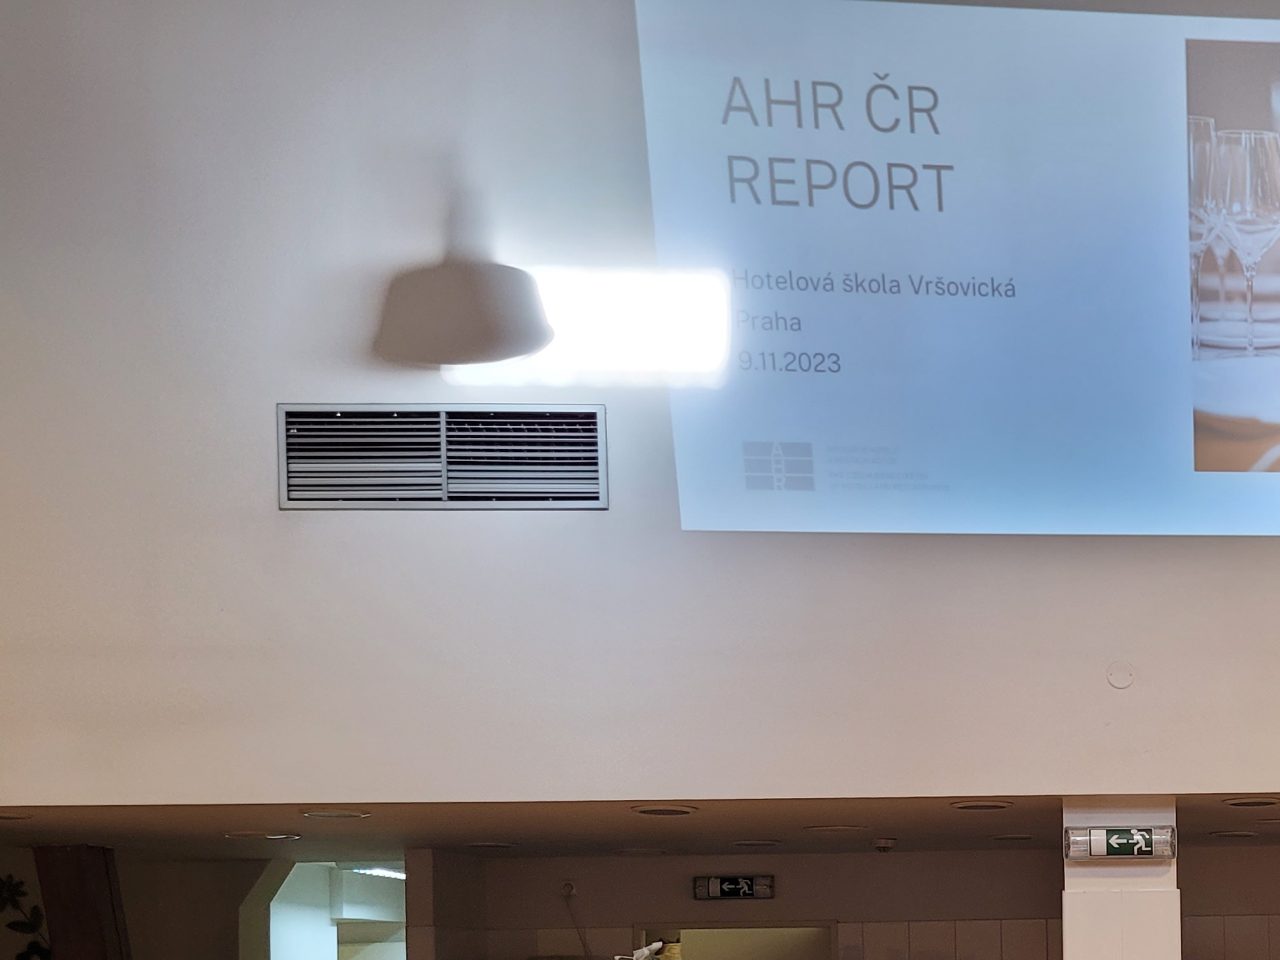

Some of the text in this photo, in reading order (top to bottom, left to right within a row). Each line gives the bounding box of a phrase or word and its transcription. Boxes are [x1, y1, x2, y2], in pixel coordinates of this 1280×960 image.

[721, 72, 941, 135] AHR ČR
[726, 155, 954, 212] REPORT
[732, 269, 1016, 298] Hotelová škola Vršovická
[735, 310, 802, 332] Praha
